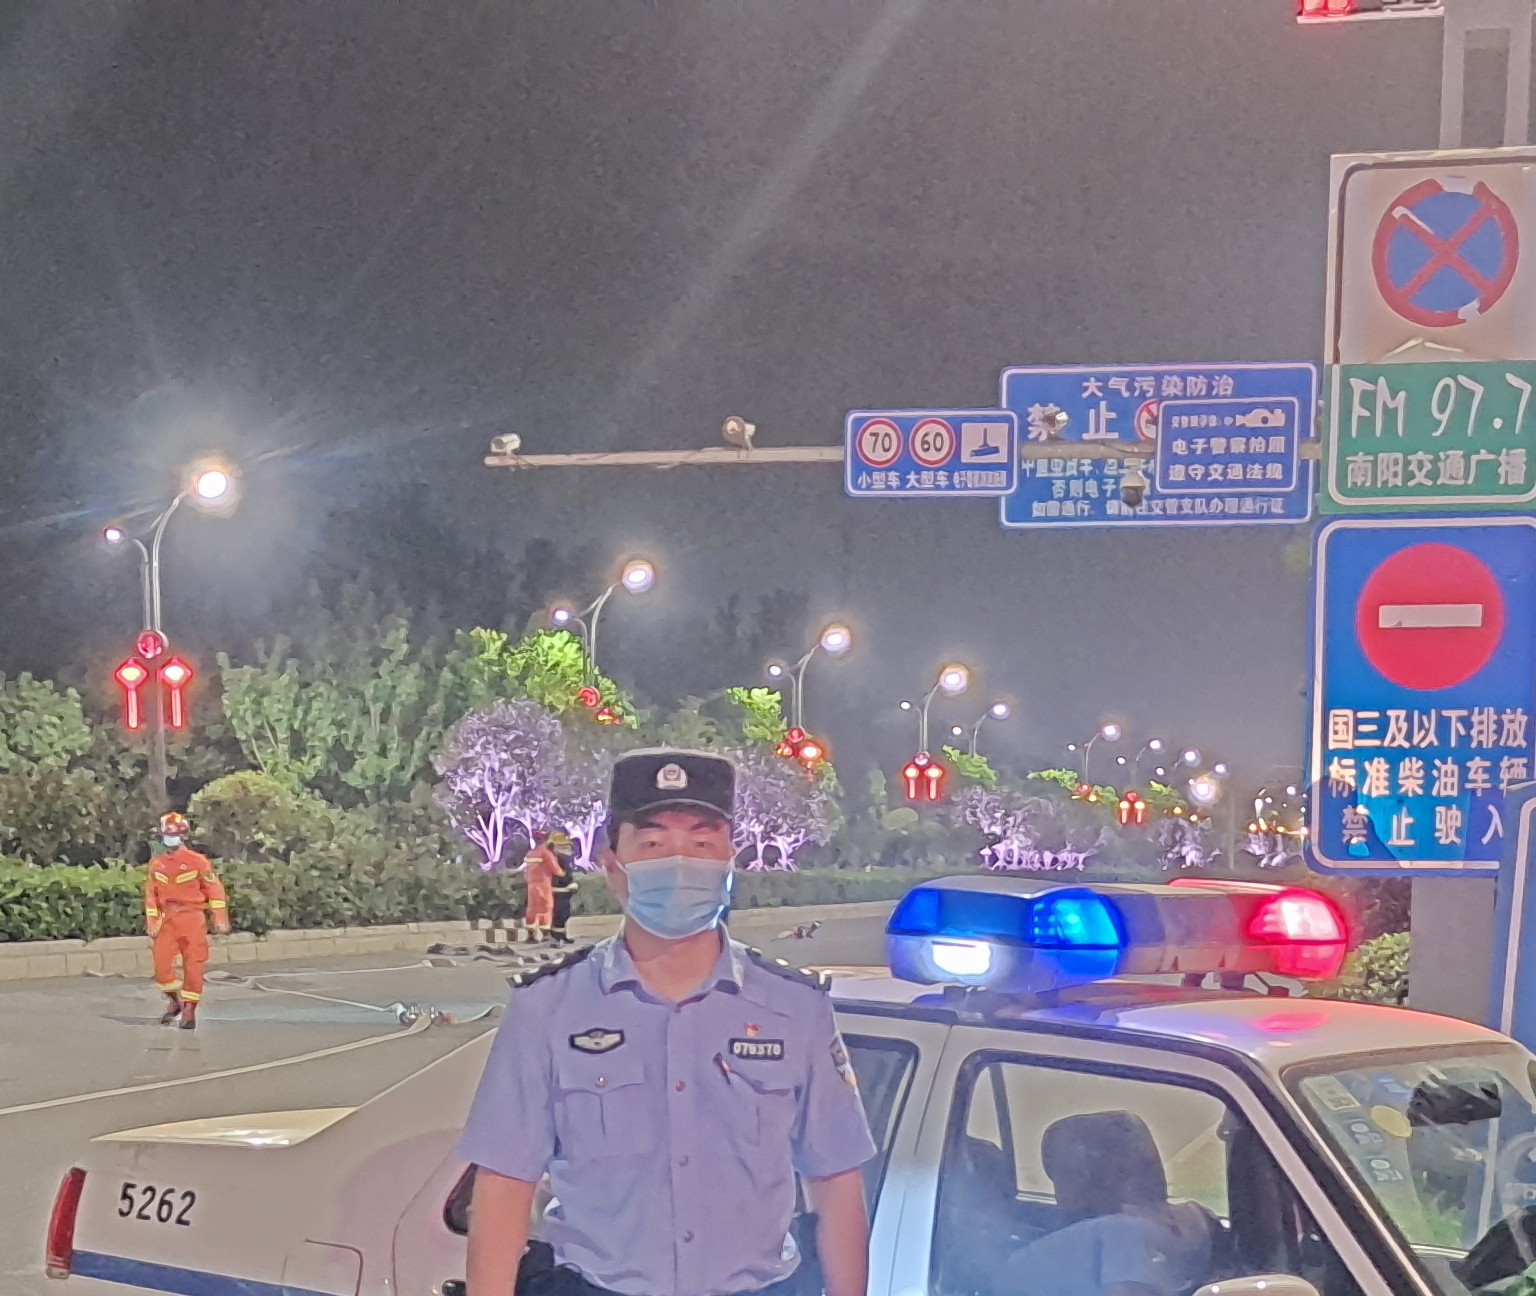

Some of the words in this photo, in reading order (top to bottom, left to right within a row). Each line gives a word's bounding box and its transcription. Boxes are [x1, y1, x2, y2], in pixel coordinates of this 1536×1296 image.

[1081, 374, 1234, 398] 大气污染防治
[1349, 376, 1405, 438] FM
[1430, 372, 1533, 437] 97.7
[869, 432, 893, 453] 70
[920, 431, 944, 453] 60
[1345, 449, 1527, 488] 南阳交通广播
[1327, 707, 1529, 750] 国三及以下排放
[1328, 756, 1528, 799] 标准柴油车辆
[1341, 804, 1503, 847] 禁止驶入
[116, 1181, 197, 1227] 5262
